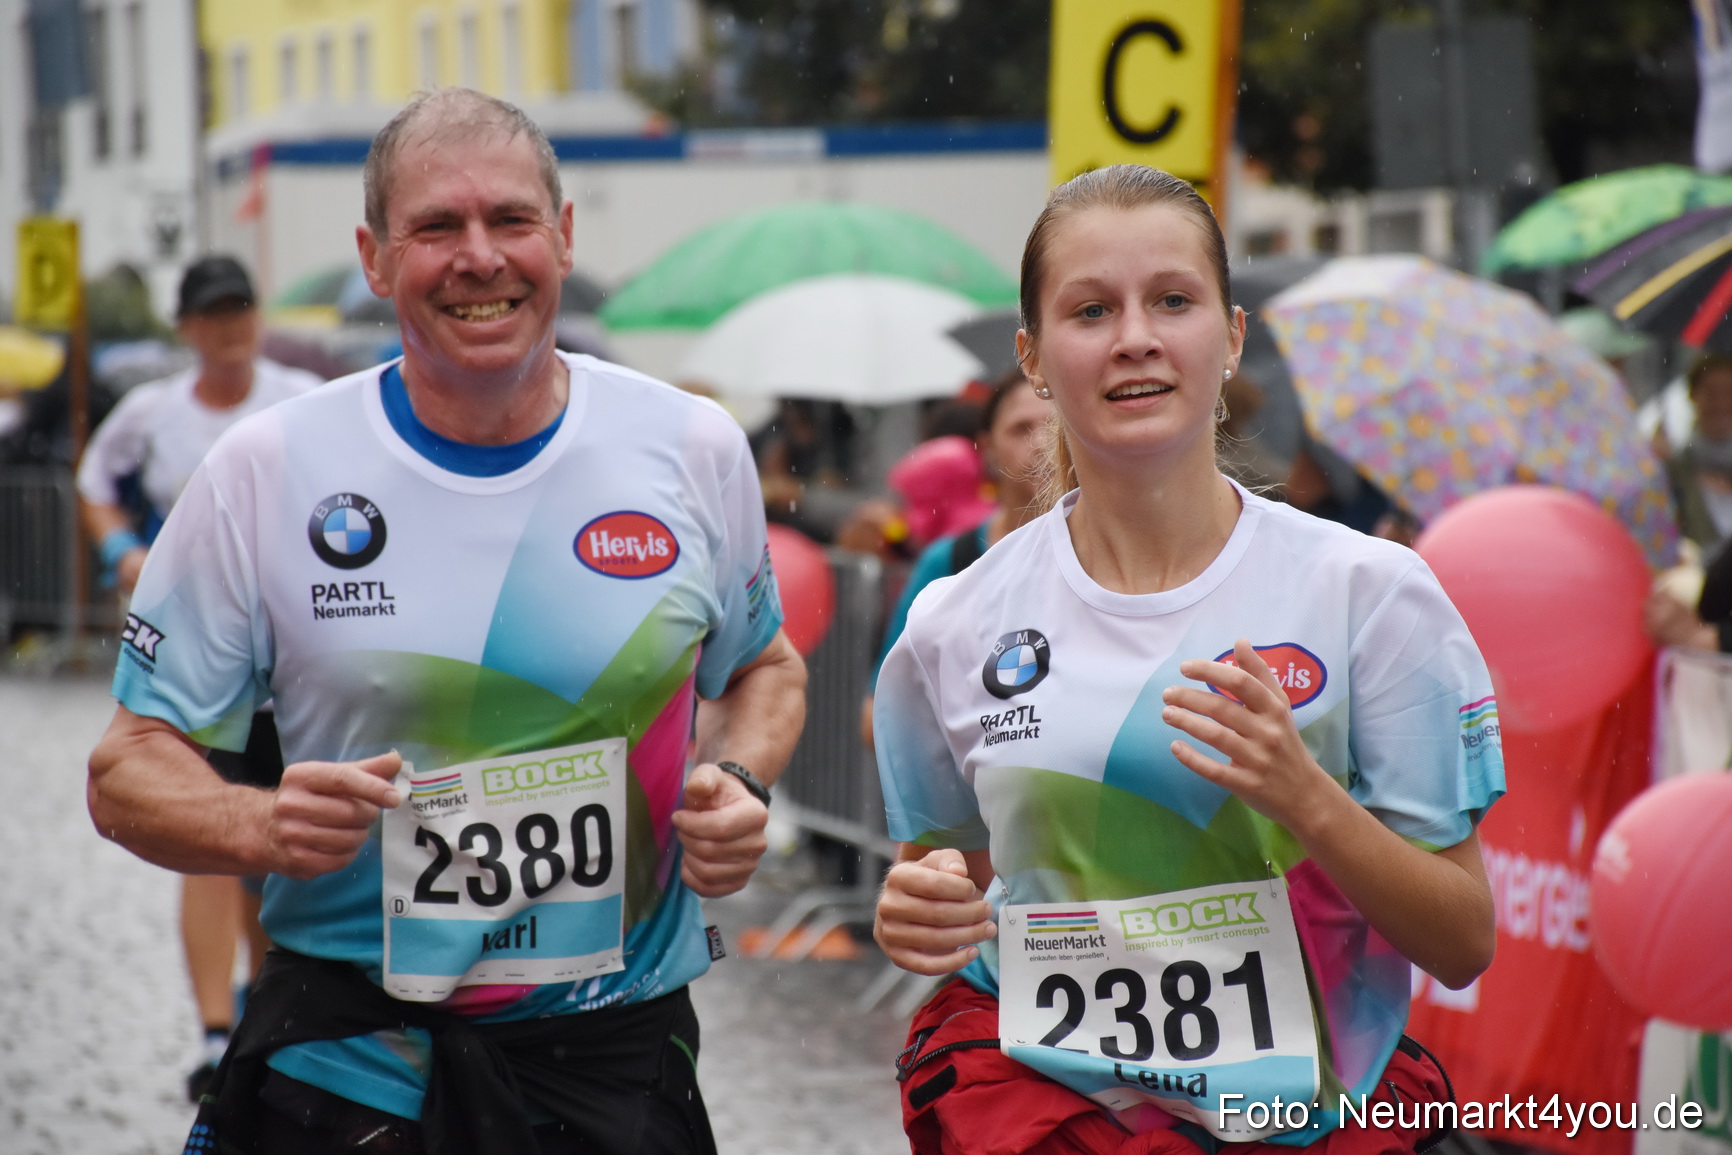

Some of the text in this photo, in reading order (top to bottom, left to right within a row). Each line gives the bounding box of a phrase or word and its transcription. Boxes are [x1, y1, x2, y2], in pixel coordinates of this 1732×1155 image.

[1103, 19, 1184, 143] C
[315, 494, 379, 520] BMW
[589, 530, 669, 561] Hervis
[311, 582, 395, 604] PARTL
[313, 602, 396, 620] Neumarkt
[991, 630, 1047, 656] BMW
[980, 704, 1042, 733] PARTL
[983, 725, 1041, 748] Neumarkt
[482, 750, 609, 797] BOCK
[485, 779, 612, 808] inspired by smart concepts
[413, 803, 613, 907] 2380
[1118, 892, 1267, 940] BOCK
[1024, 934, 1107, 951] NeuerMarkt
[1125, 925, 1270, 952] inspired by smart concepts
[1036, 951, 1275, 1061] 2381
